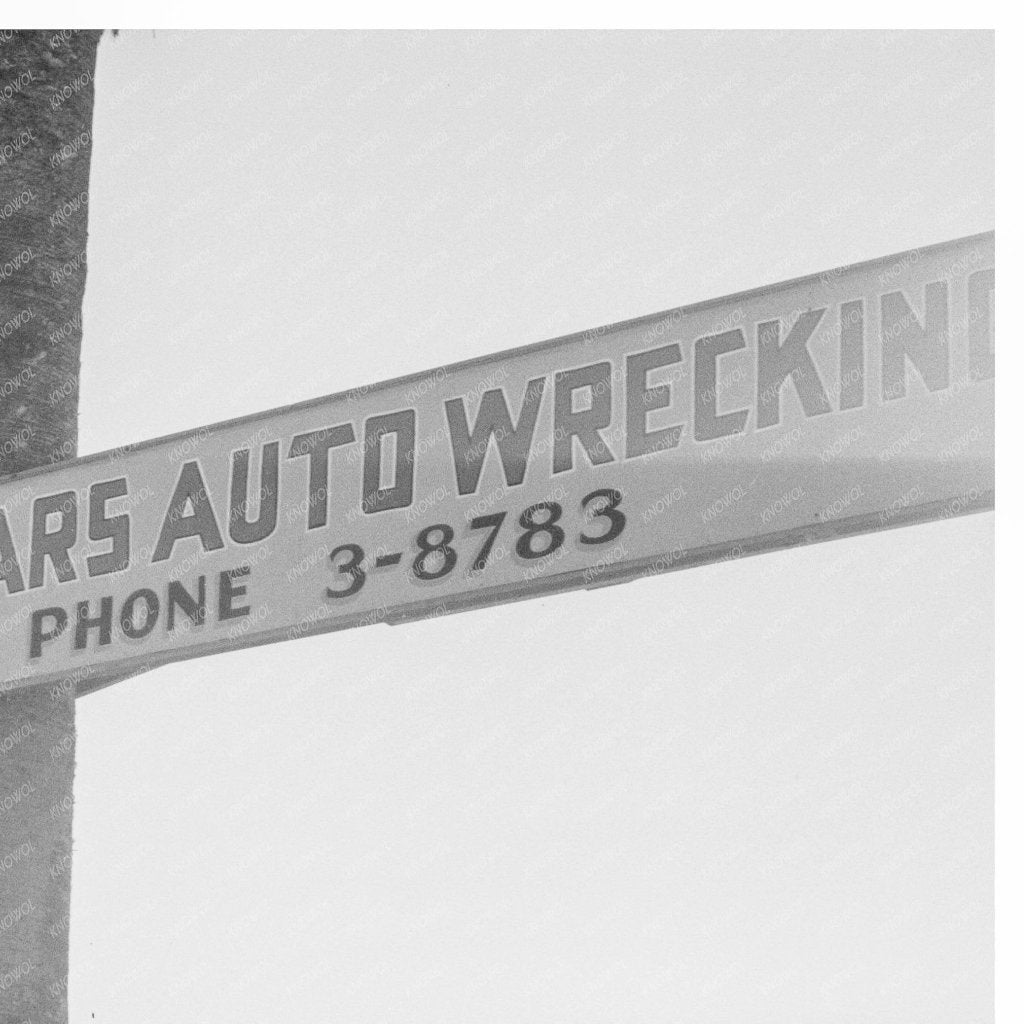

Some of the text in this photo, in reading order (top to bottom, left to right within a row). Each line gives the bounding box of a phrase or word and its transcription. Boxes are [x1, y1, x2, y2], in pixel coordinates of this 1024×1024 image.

[151, 408, 415, 564] AUTO
[29, 488, 627, 659] PHONE 3-8783
